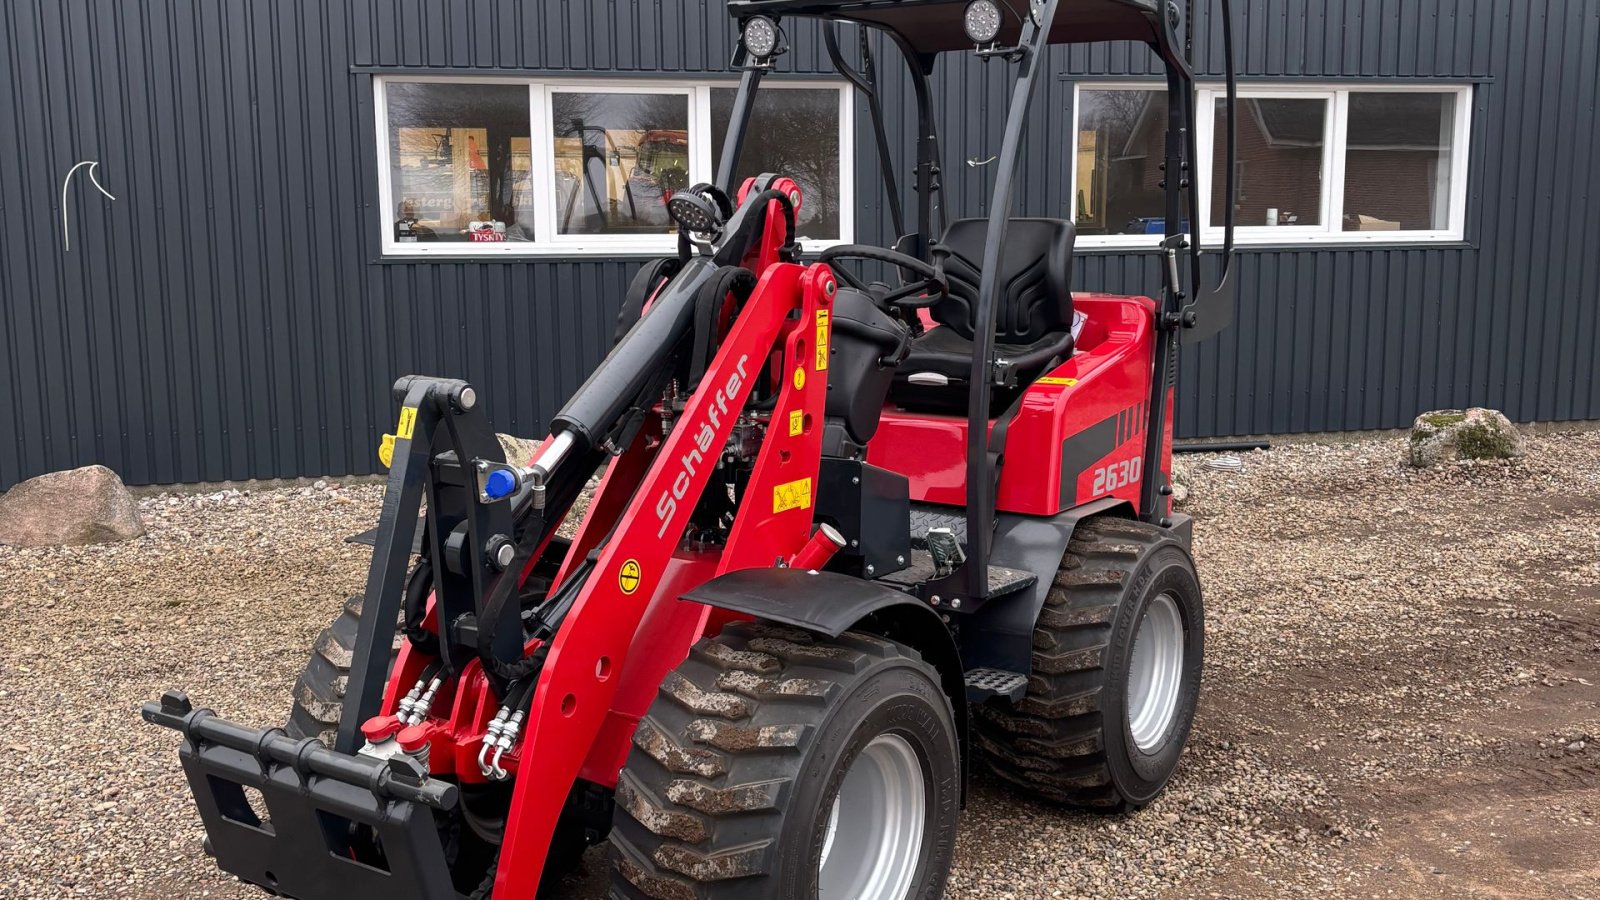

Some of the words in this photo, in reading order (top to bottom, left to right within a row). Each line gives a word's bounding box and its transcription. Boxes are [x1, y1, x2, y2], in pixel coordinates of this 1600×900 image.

[656, 354, 749, 540] Schäffer
[1092, 456, 1142, 497] 2630
[1117, 600, 1136, 648] POWER
